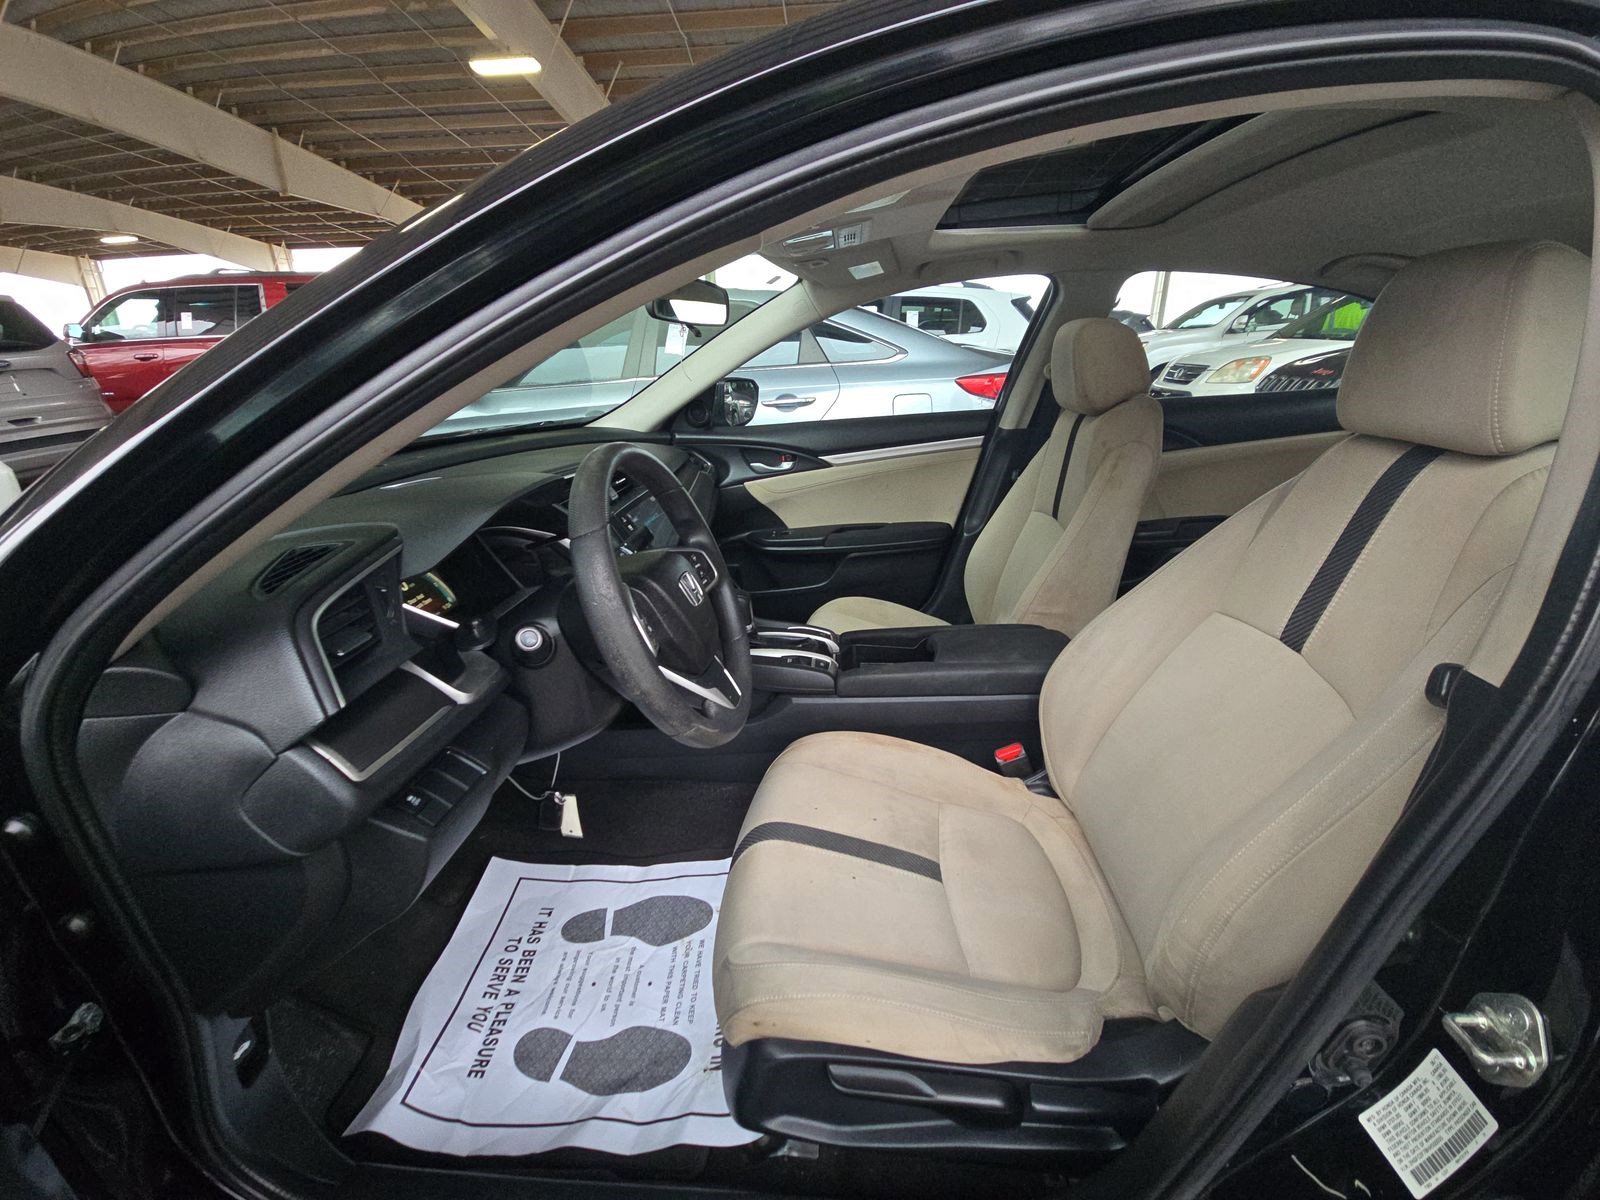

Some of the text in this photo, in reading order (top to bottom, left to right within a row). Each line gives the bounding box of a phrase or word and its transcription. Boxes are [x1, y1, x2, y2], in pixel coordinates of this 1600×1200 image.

[467, 937, 522, 1033] TO SERVE YOU
[467, 907, 554, 1079] IT HAS BEEN A PLEASURE
[659, 946, 678, 1022] WITH THIS PAPER MAT
[672, 941, 692, 1026] YOUR CARPETING CLEAN
[688, 939, 705, 1024] WE HAVE TRIED TO KEEP
